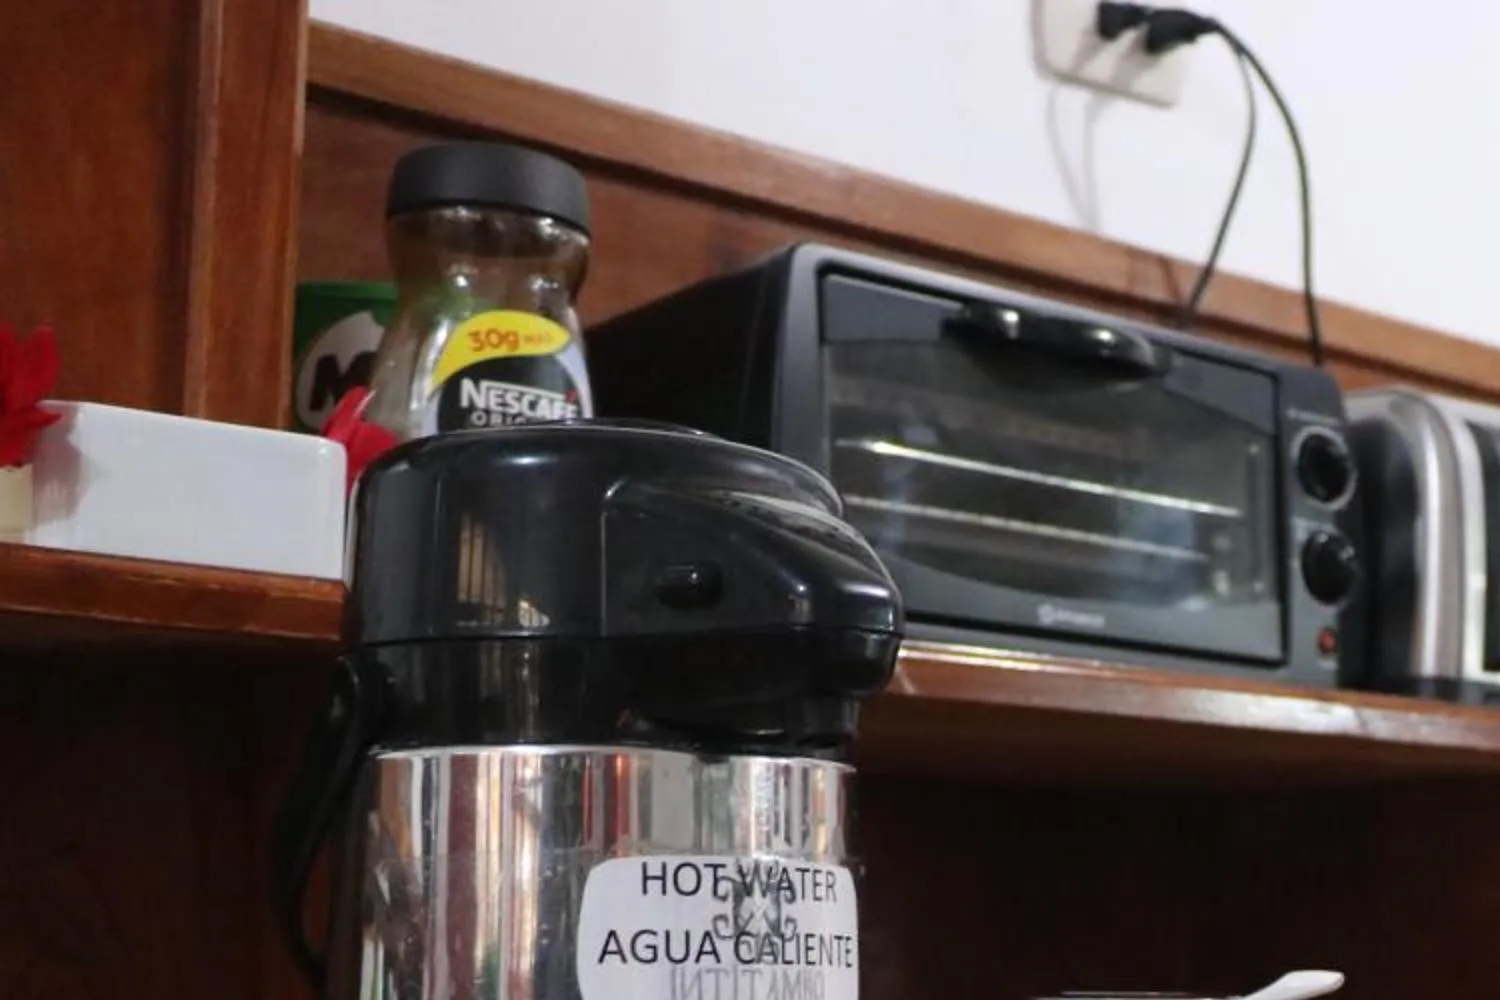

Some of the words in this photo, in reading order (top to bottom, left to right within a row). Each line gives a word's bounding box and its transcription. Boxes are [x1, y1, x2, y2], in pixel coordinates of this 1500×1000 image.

[642, 860, 727, 897] HOT
[737, 862, 838, 902] WATER
[597, 928, 721, 965] AGUA
[733, 930, 853, 968] CALIENTE
